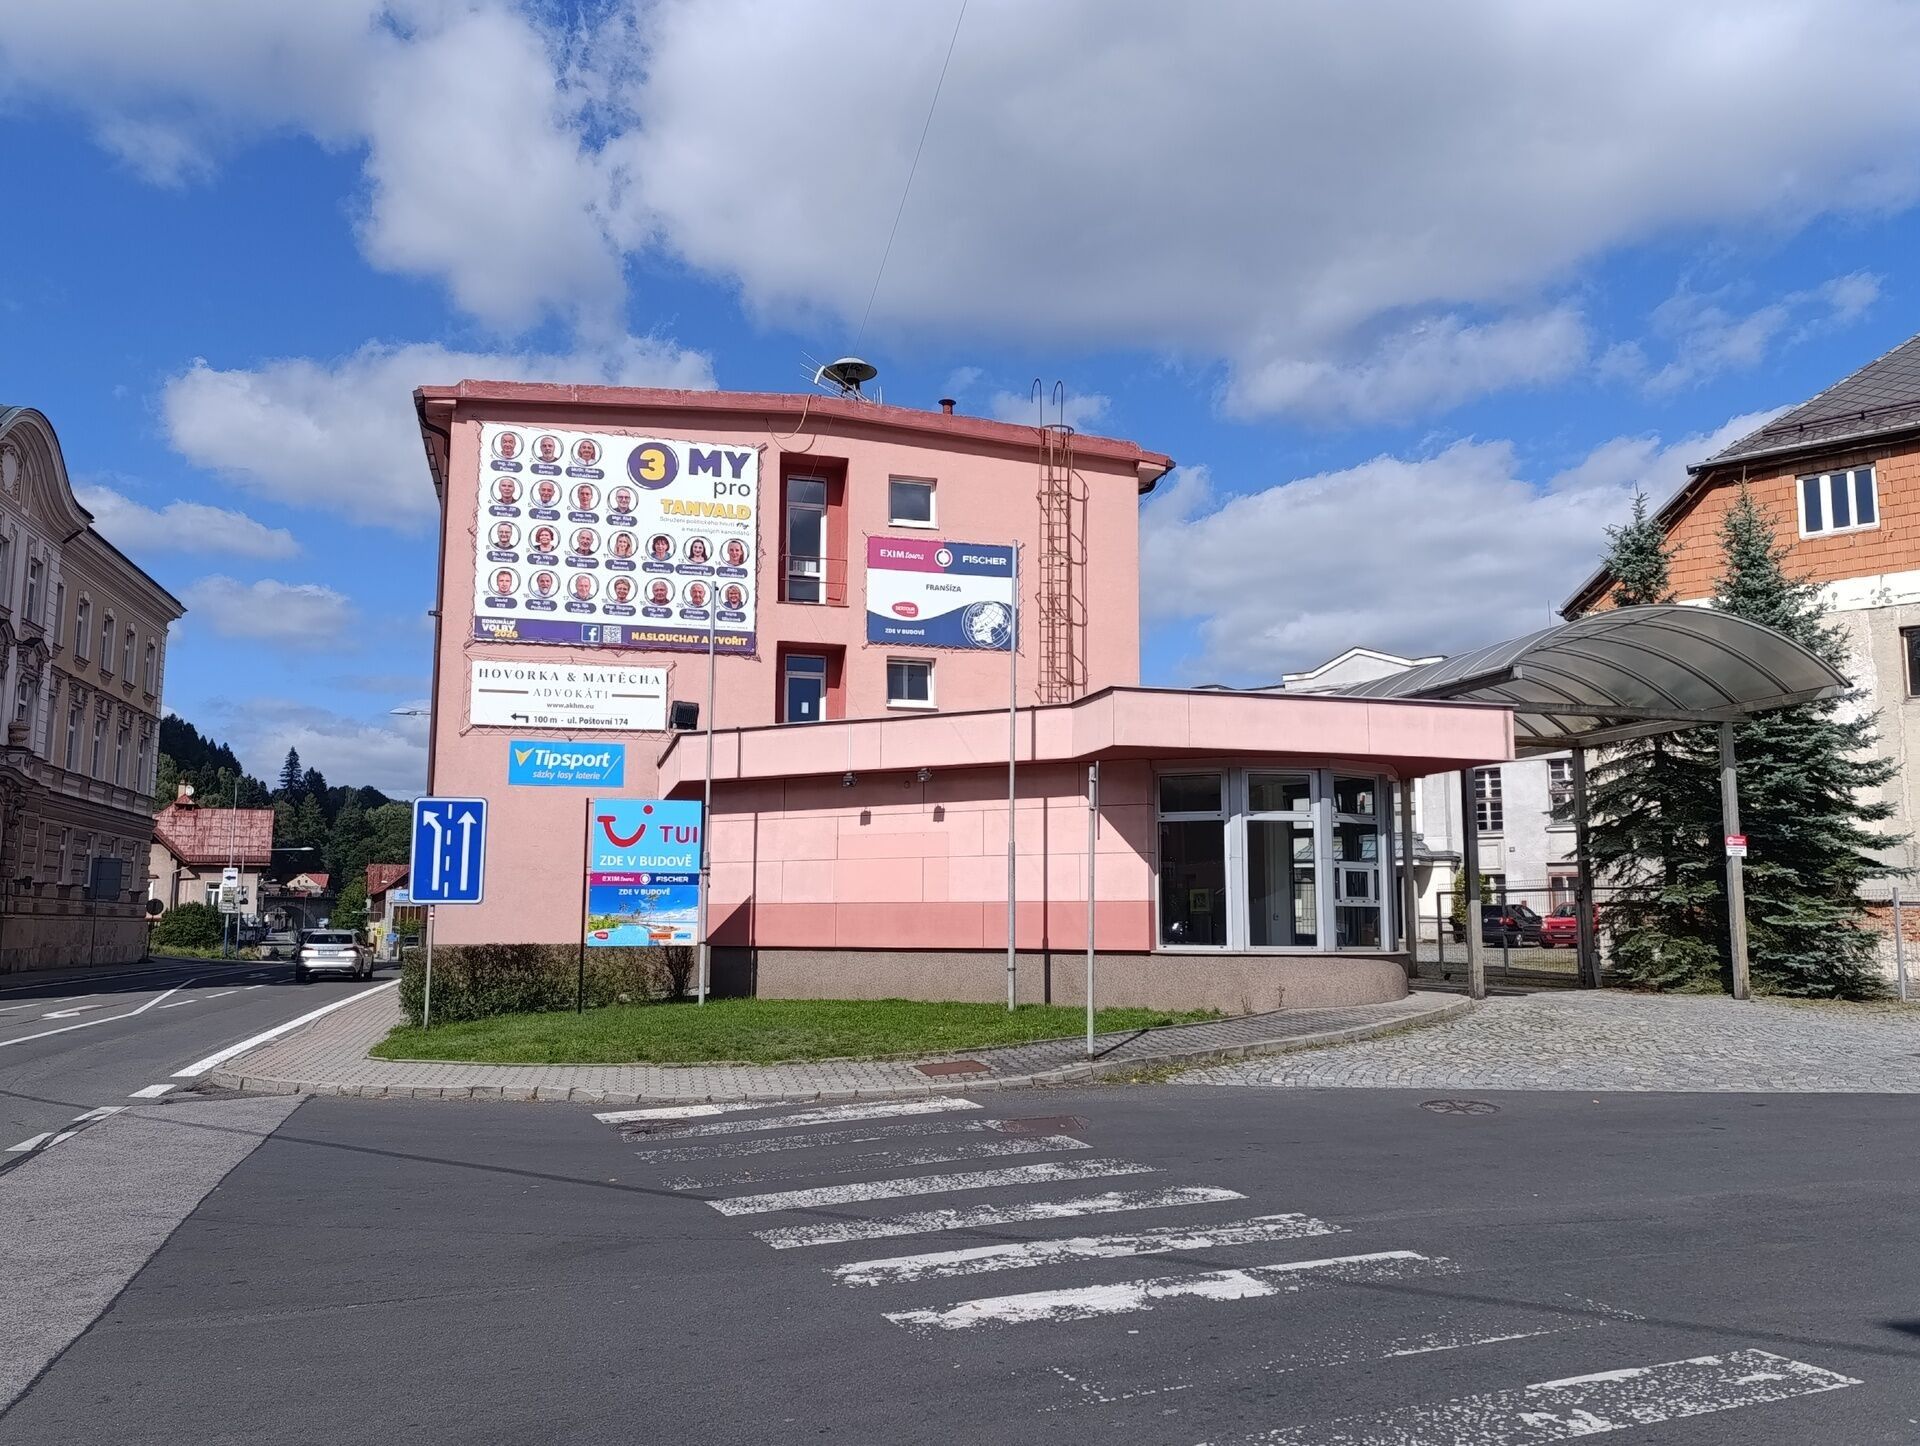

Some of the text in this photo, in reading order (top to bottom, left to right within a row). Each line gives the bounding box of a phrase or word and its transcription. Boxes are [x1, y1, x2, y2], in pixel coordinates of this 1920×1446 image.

[640, 448, 666, 481] 3
[689, 448, 751, 479] MY
[714, 481, 750, 498] pro
[661, 498, 752, 520] TANVALD
[686, 518, 718, 526] politického
[962, 555, 1007, 565] FISCHER
[926, 583, 962, 593] FRANŠÍZA
[482, 624, 515, 632] VOLBY
[494, 630, 518, 638] 2026
[631, 632, 700, 643] NASLOUCHAT
[714, 636, 748, 645] TVOŘIT
[478, 667, 661, 686] HOVORKA & MATĚCHA
[532, 687, 608, 700] ADVOKÁTI
[533, 715, 548, 724] 100
[567, 716, 577, 725] ul.
[578, 716, 612, 726] Poštovní
[614, 717, 629, 726] 174
[535, 748, 610, 769] Tipsport
[532, 771, 601, 781] sázky losy loterie
[659, 826, 698, 844] TUI
[600, 853, 692, 867] ZDE V BUDOVĚ
